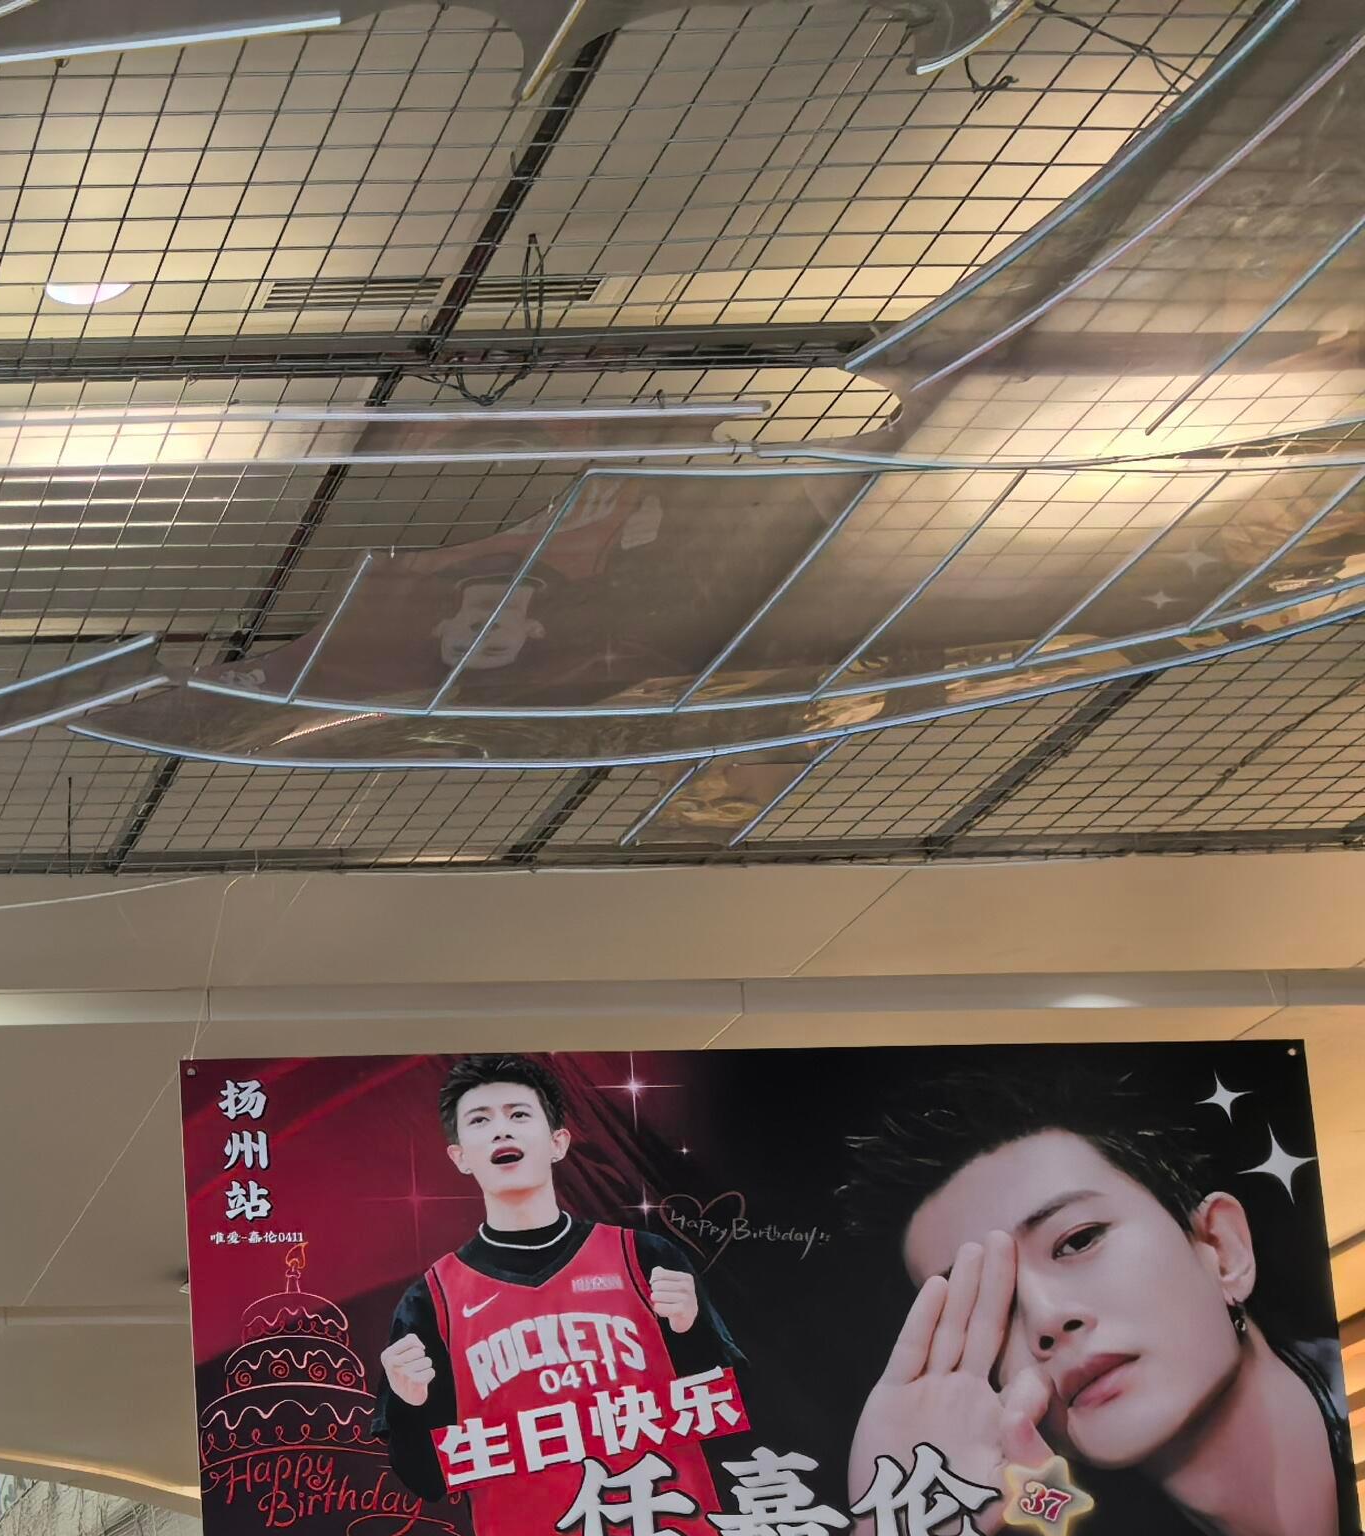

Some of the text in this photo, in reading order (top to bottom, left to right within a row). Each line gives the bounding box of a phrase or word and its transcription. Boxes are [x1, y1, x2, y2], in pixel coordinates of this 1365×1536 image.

[218, 1080, 272, 1221] 扬州站
[465, 1311, 647, 1400] ROCKETS
[438, 1365, 742, 1486] 生日快乐
[207, 1453, 334, 1504] Happy
[1020, 1481, 1071, 1522] 37
